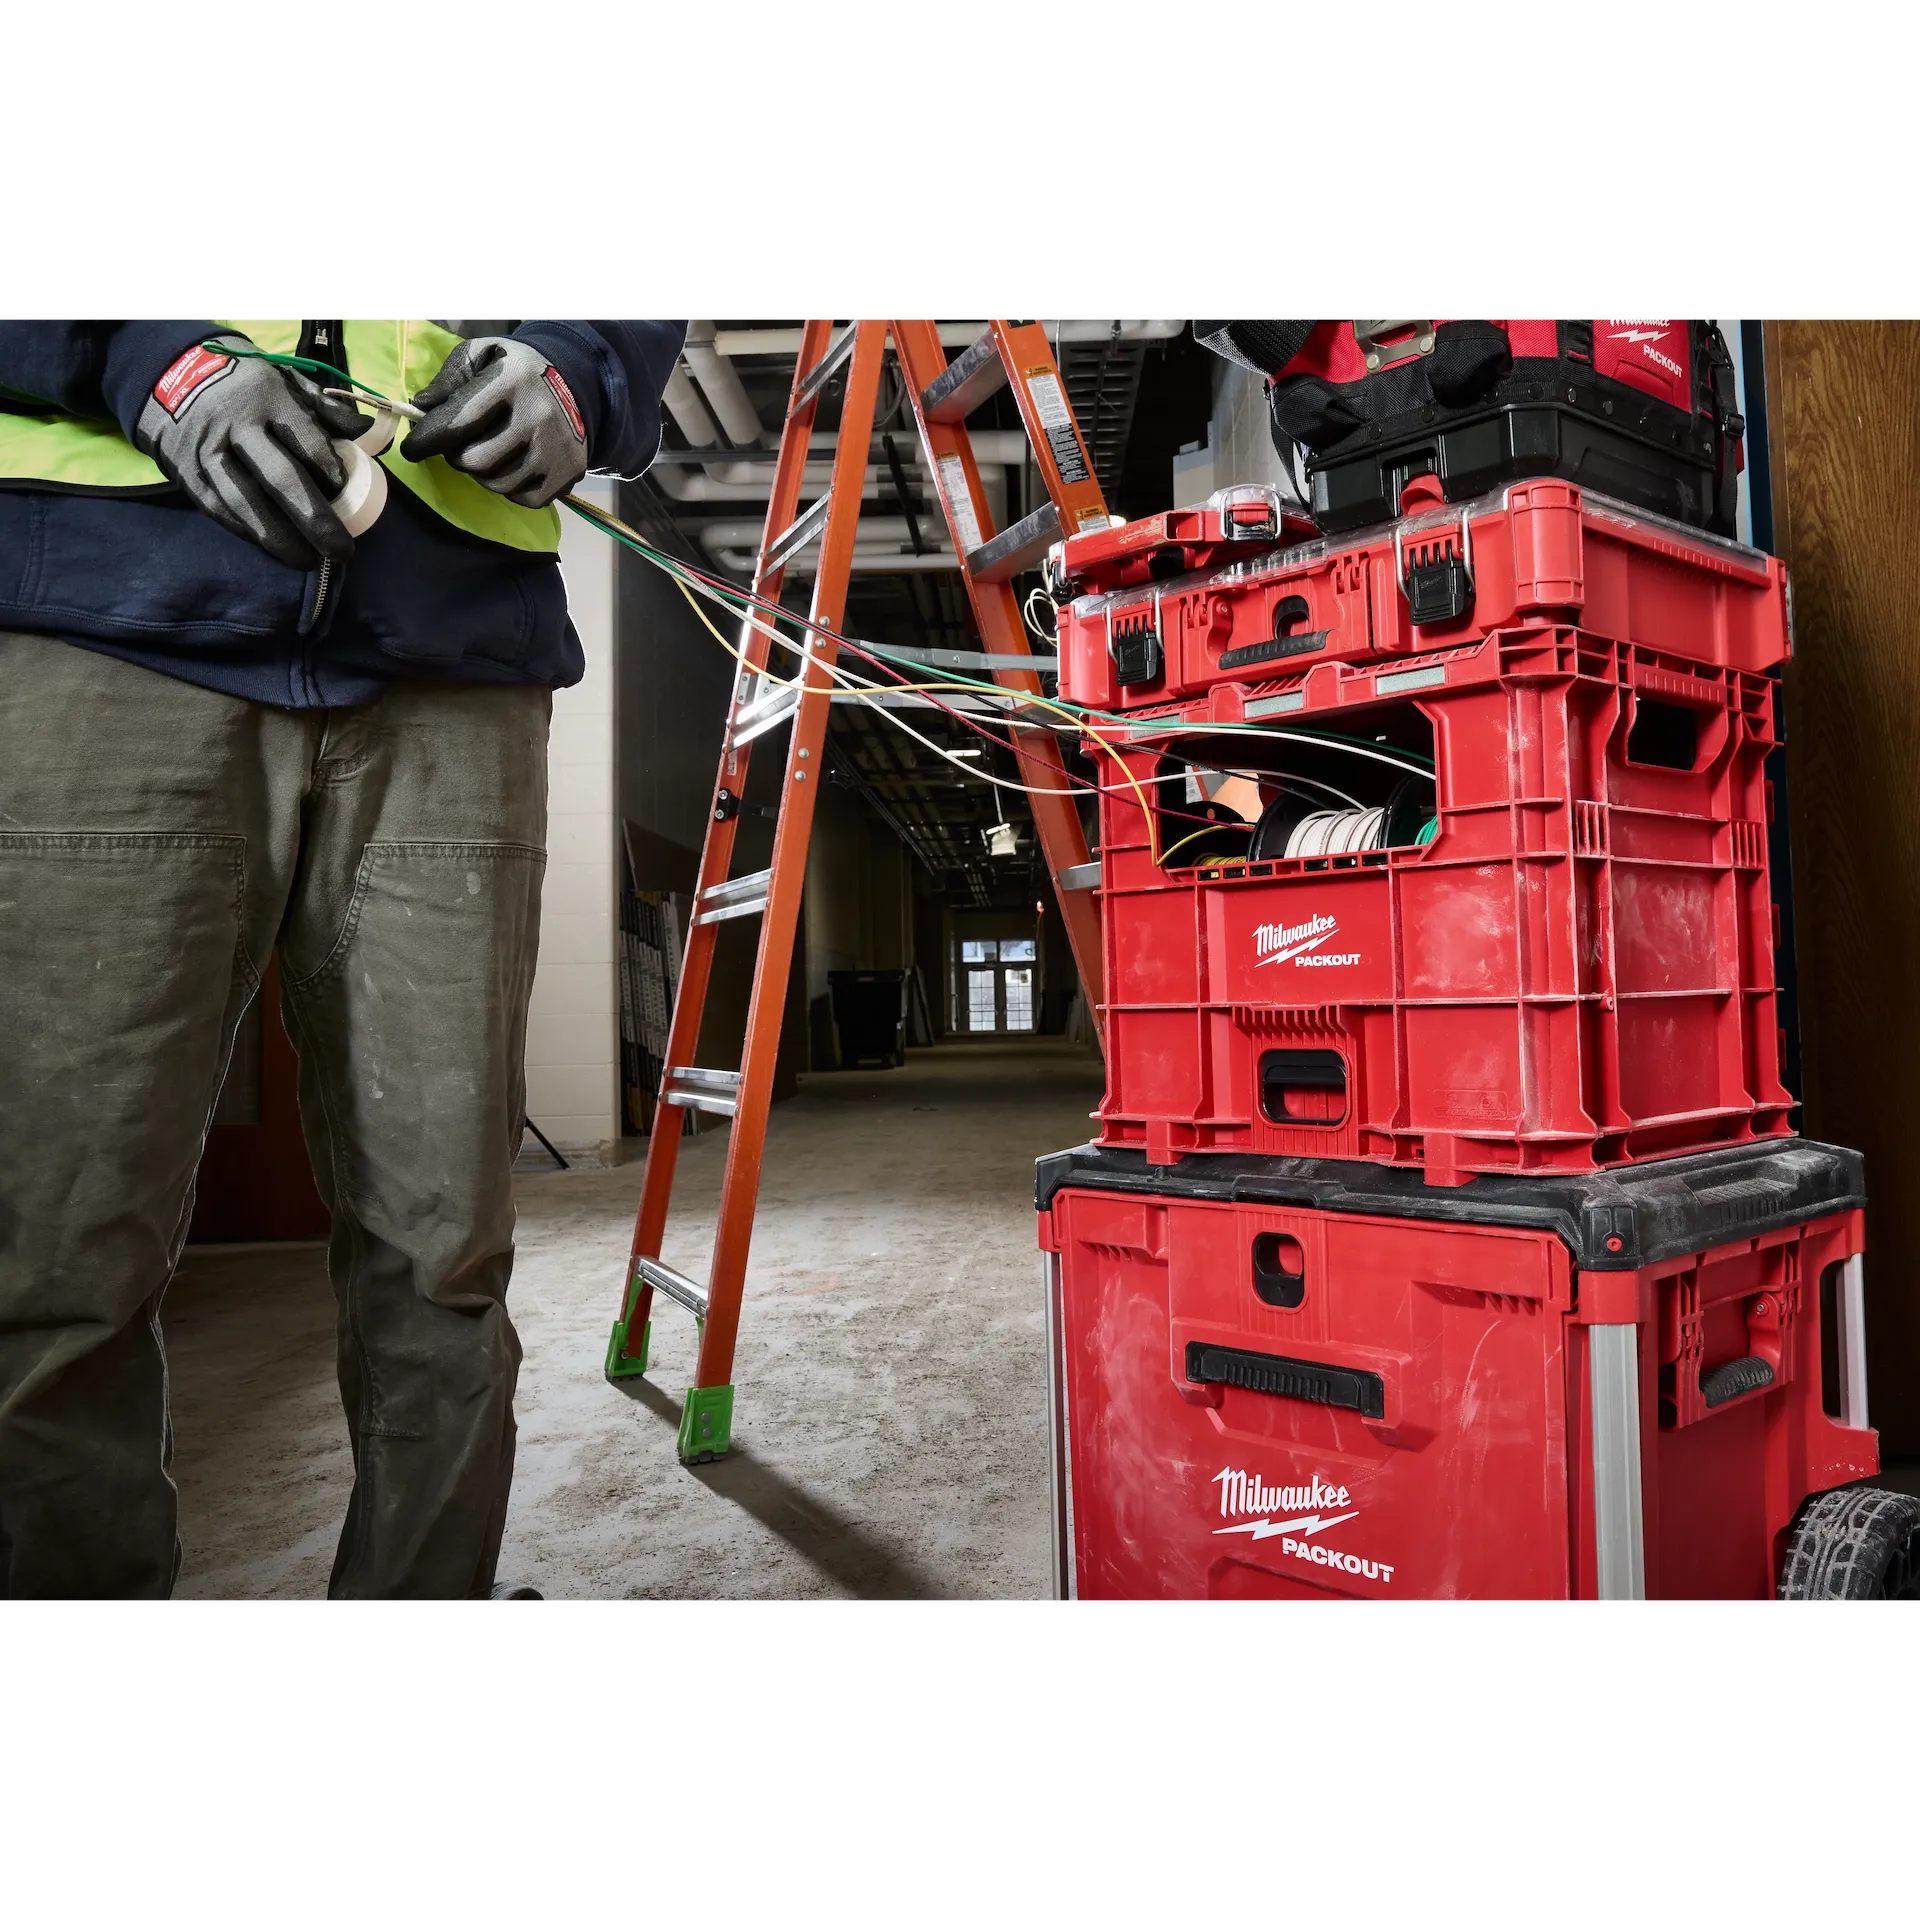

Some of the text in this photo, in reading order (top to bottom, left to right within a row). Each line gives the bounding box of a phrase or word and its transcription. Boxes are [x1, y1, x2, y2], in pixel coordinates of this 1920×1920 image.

[158, 346, 203, 393] Milwaukee
[1643, 344, 1683, 378] PACKOUT
[1251, 913, 1337, 958] Milwaukee
[1295, 953, 1361, 967] PACKOUT
[1211, 1466, 1352, 1518] Milwaukee
[1282, 1537, 1395, 1583] PACKOUT
